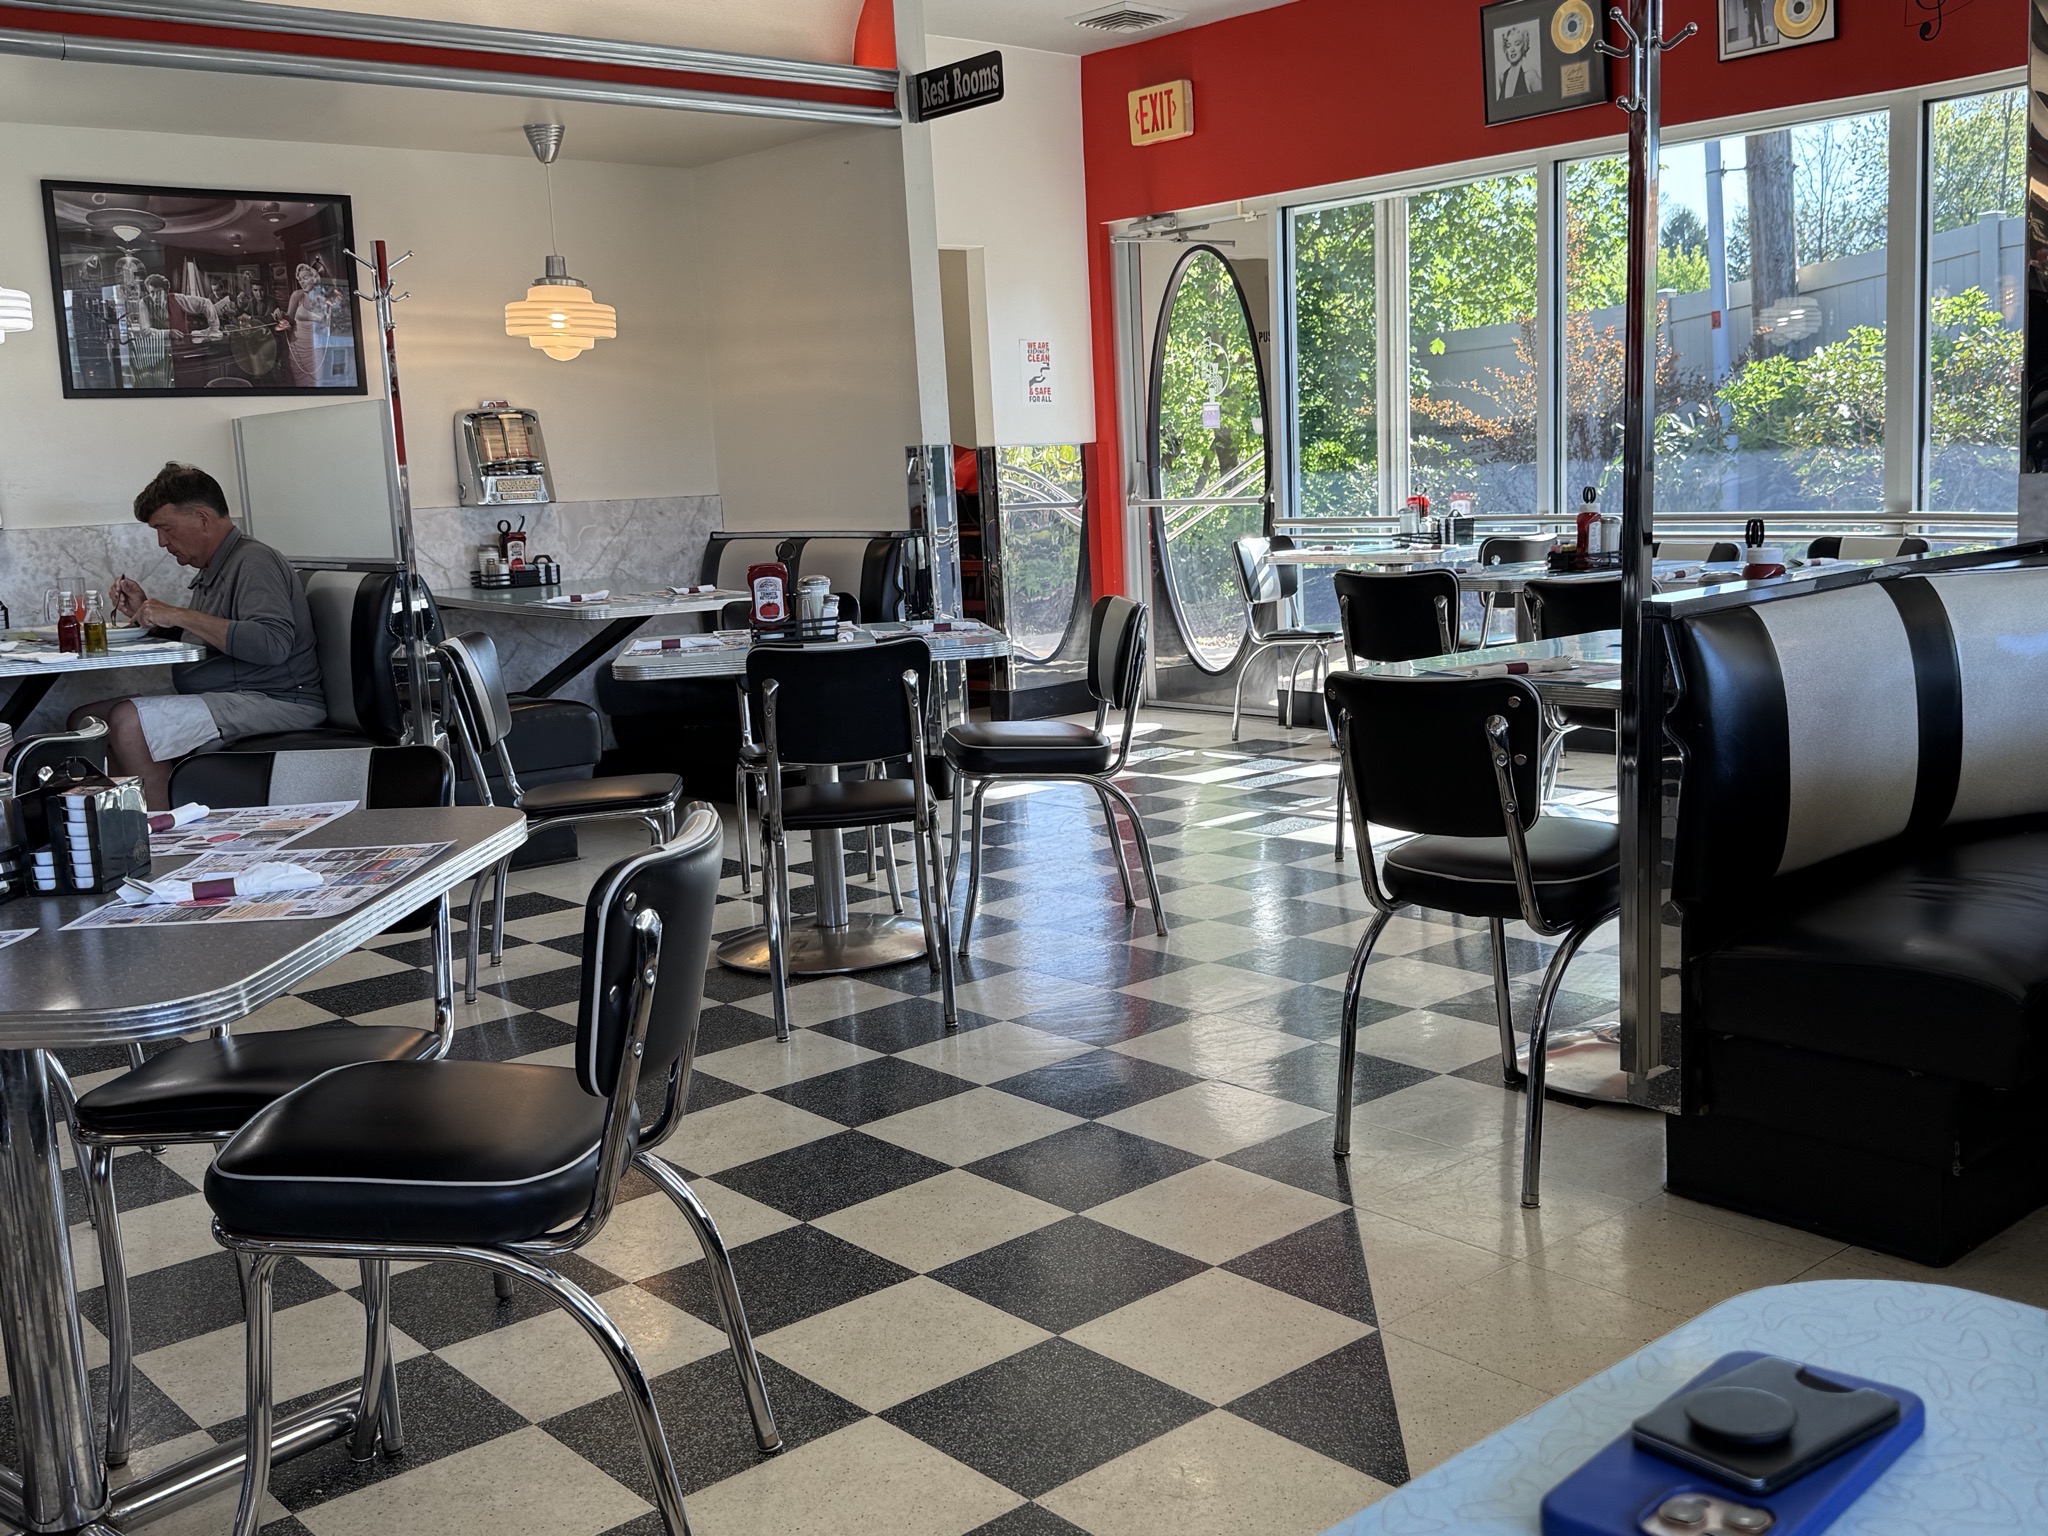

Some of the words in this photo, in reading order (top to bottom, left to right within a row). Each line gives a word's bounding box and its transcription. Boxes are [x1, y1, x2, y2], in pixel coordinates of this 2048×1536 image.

[921, 73, 950, 109] Rest
[952, 64, 1000, 100] Rooms
[1138, 88, 1174, 135] EXIT
[1027, 341, 1037, 349] WE
[1038, 341, 1049, 349] ARE
[1027, 354, 1050, 362] CLEAN
[1034, 387, 1051, 395] SAFE
